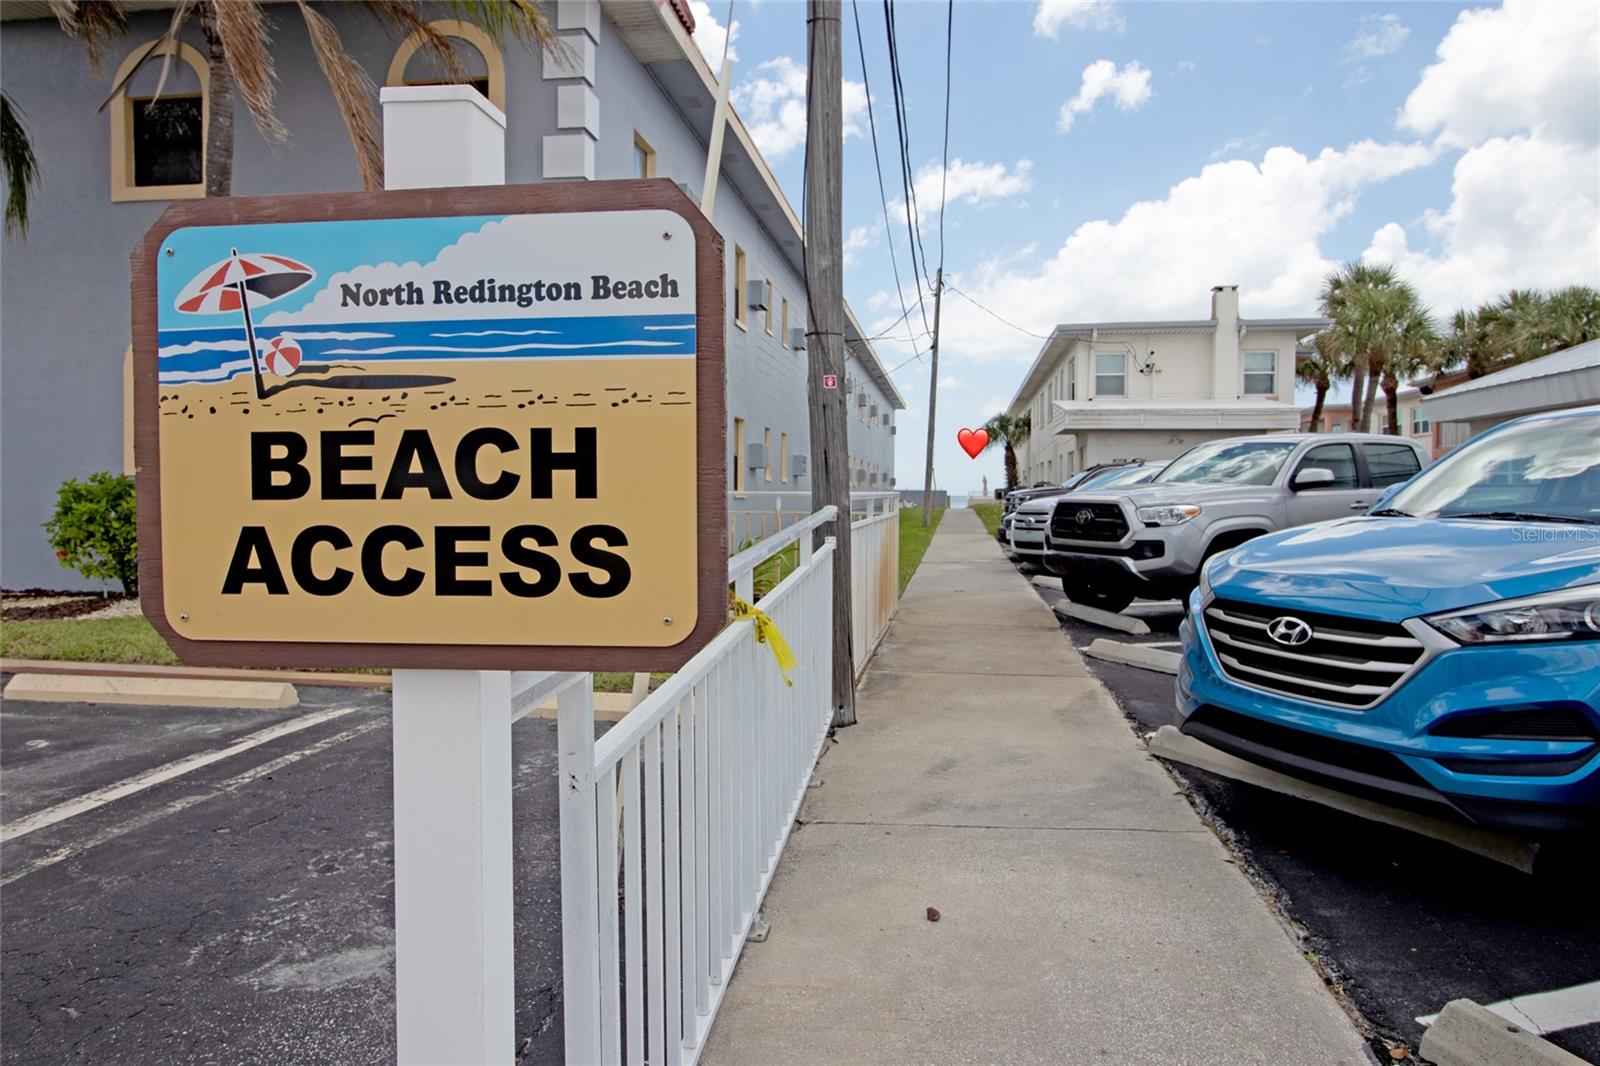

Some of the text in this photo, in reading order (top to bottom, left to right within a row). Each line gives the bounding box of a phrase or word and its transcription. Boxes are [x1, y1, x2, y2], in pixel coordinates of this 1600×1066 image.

[340, 274, 679, 307] North Redington Beach
[251, 427, 597, 500] BEACH
[223, 525, 631, 598] ACCESS
